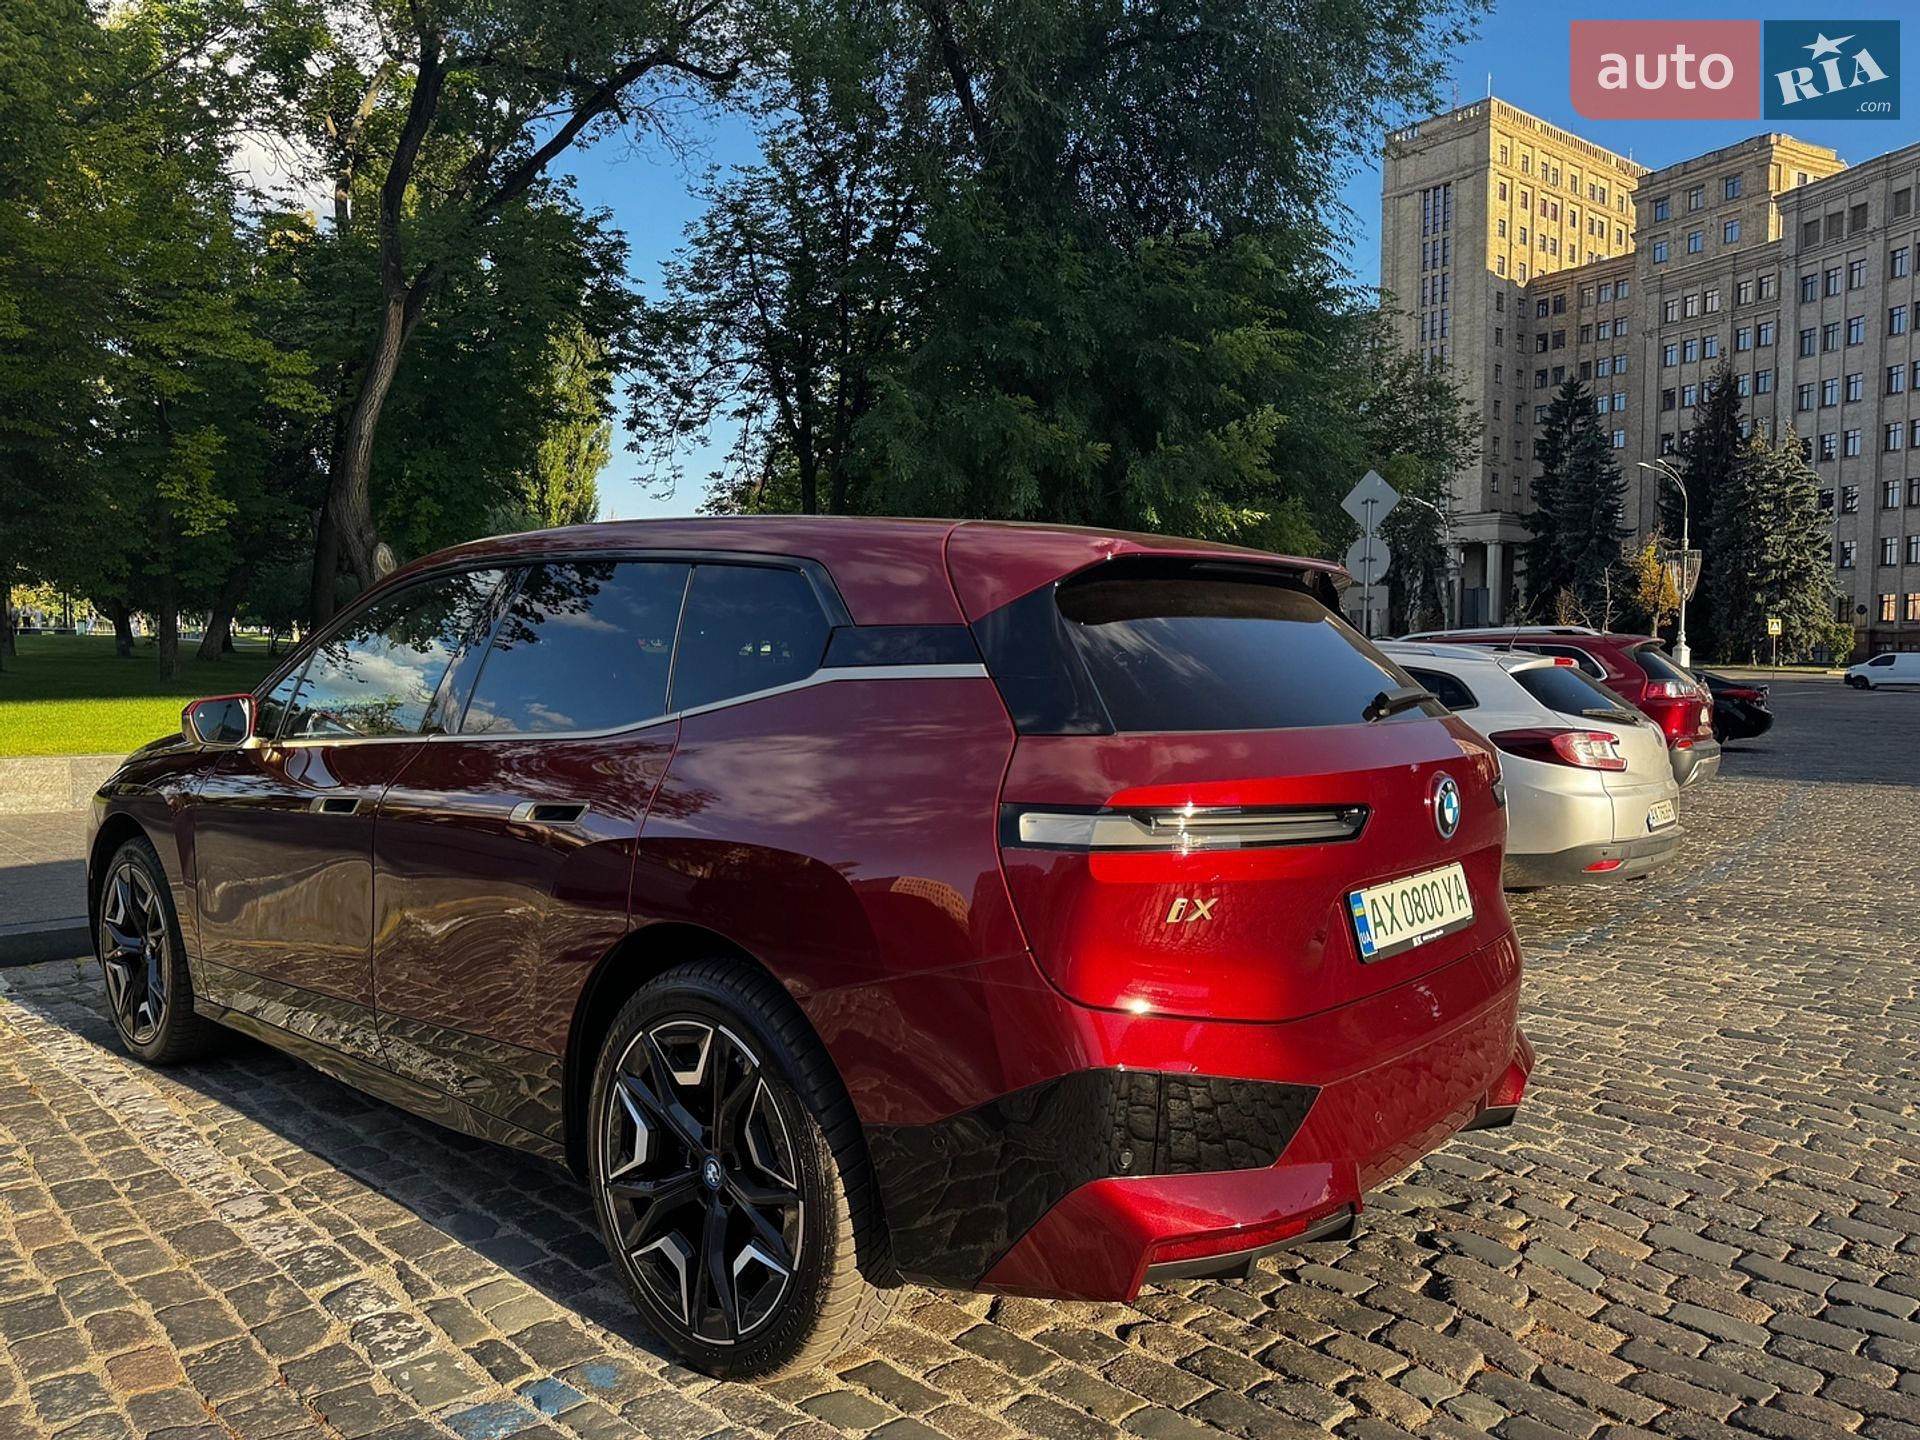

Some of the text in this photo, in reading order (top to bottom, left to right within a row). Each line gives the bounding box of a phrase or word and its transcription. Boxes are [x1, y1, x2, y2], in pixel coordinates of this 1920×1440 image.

[1370, 873, 1468, 940] AX 0800 YA
